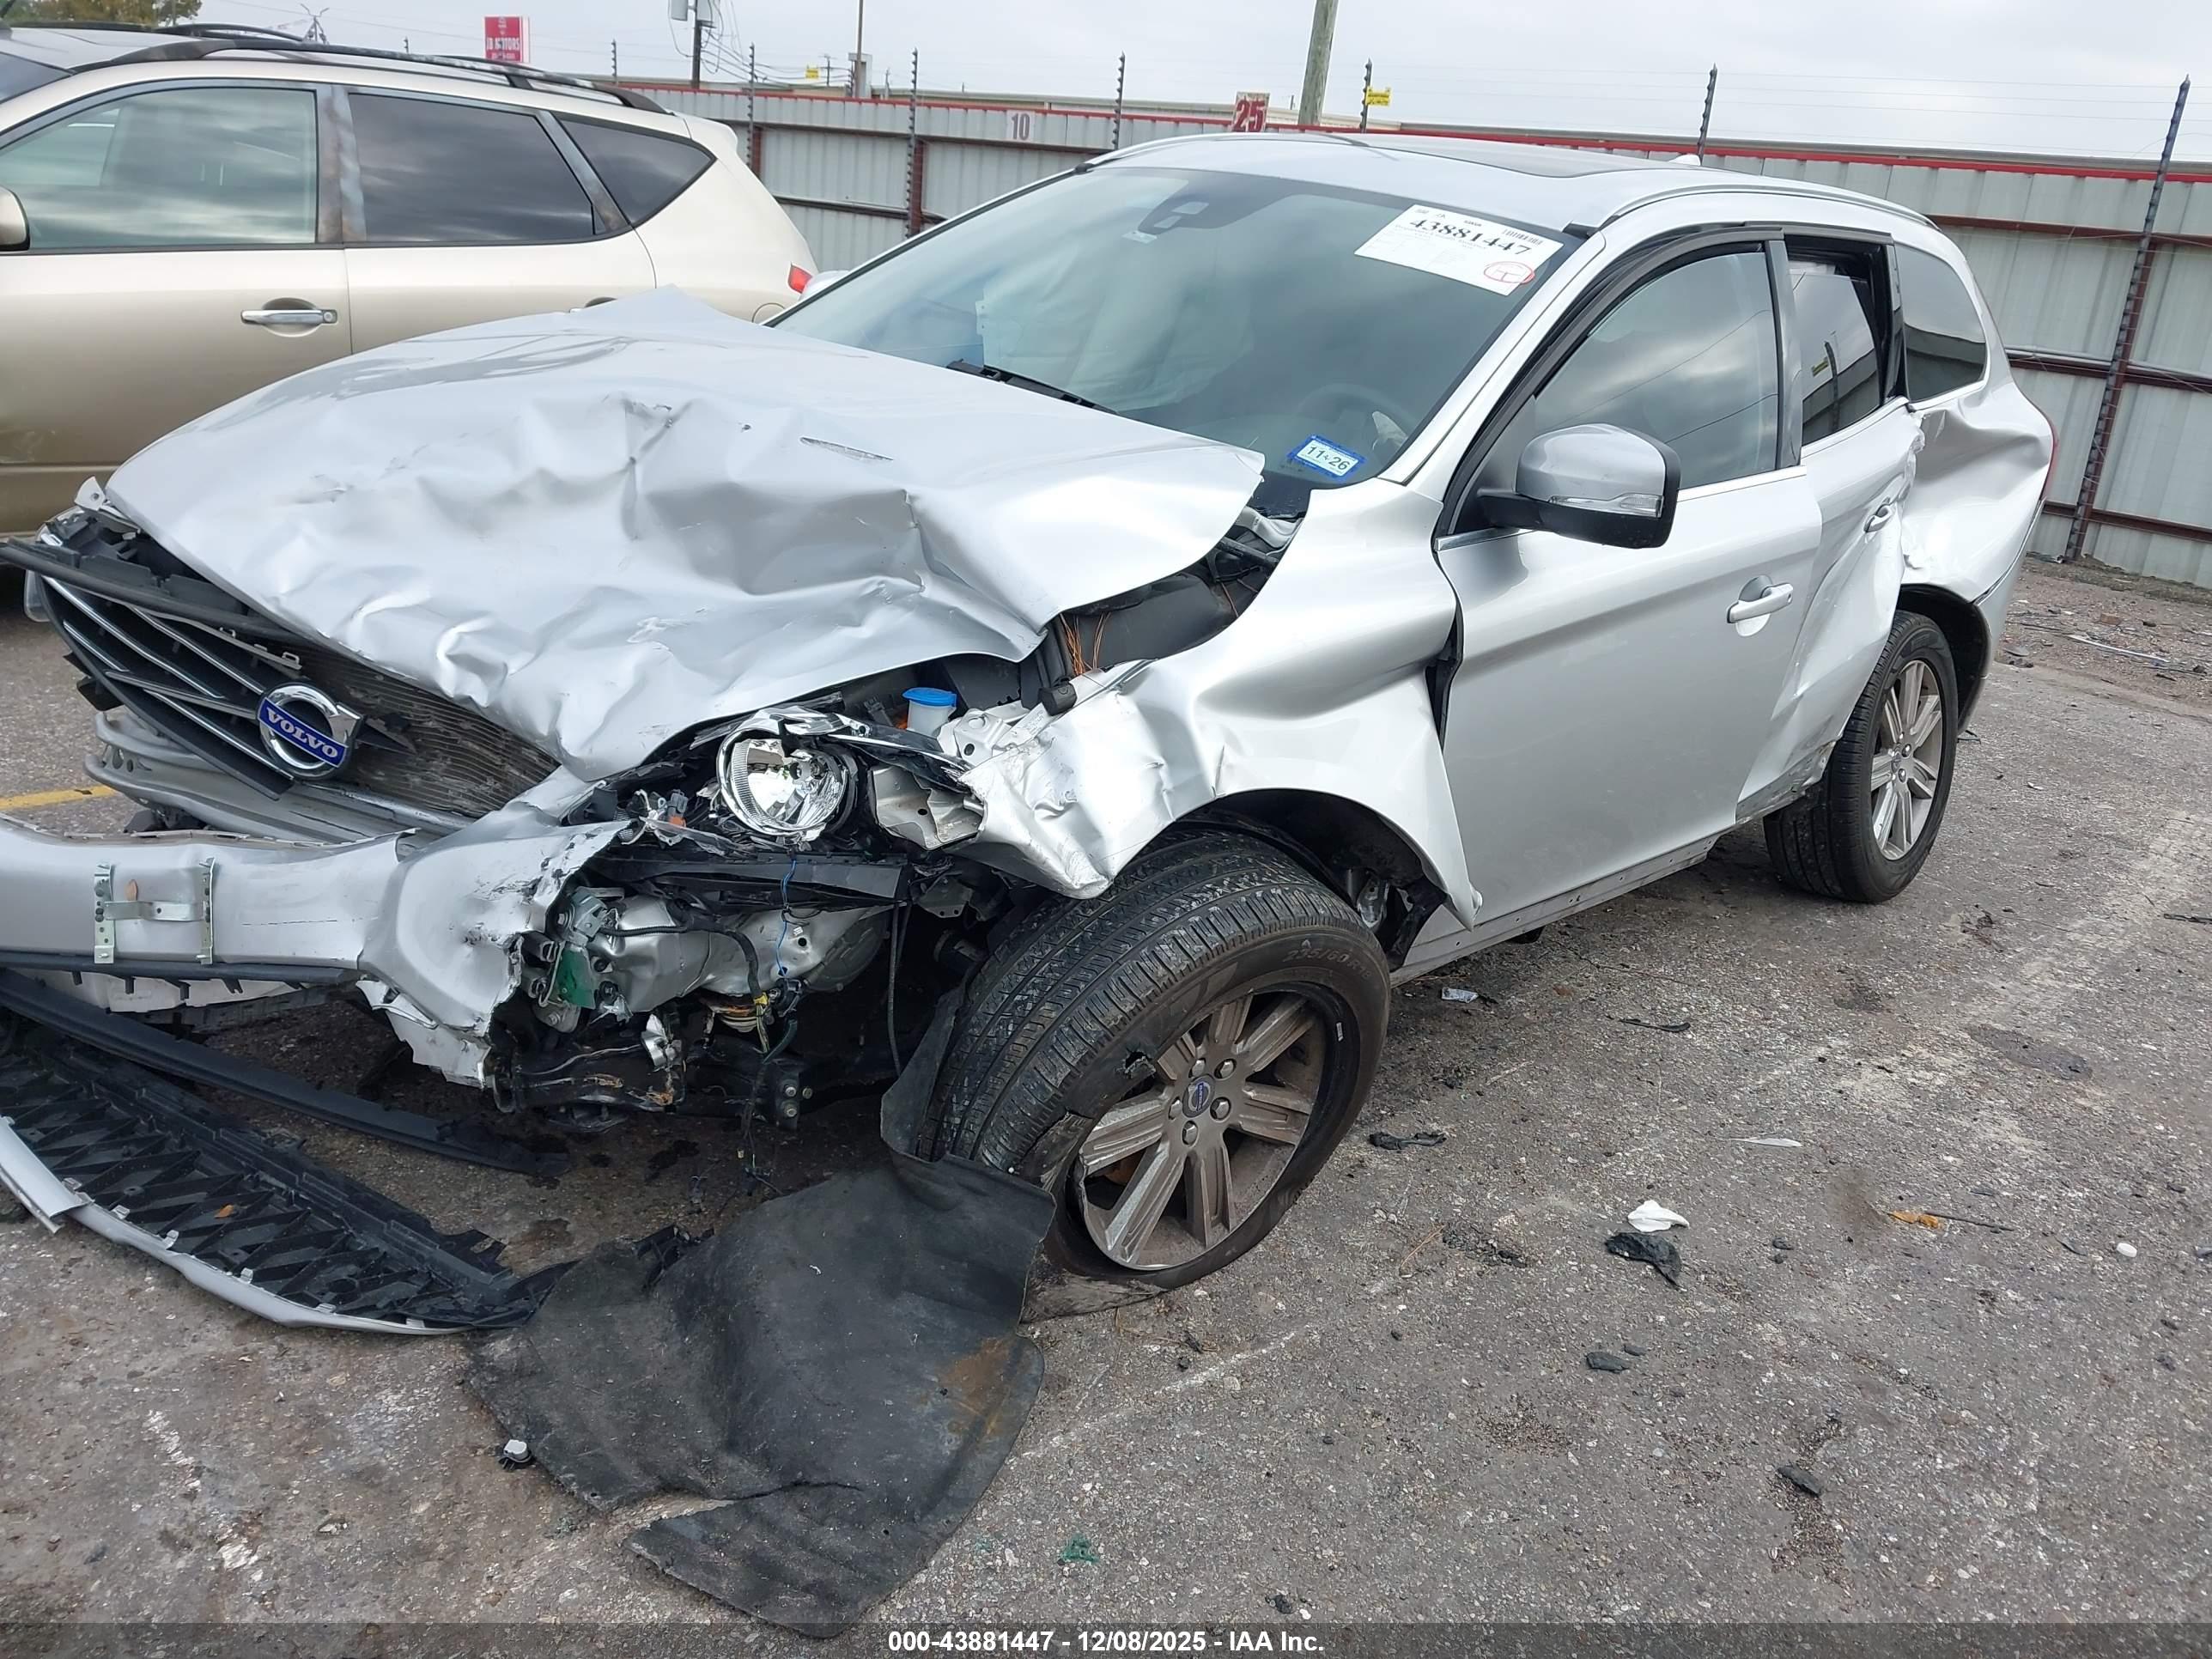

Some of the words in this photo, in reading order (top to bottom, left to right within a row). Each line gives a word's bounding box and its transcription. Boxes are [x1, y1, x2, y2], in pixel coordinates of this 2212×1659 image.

[1011, 112, 1030, 141] 10
[1231, 99, 1266, 132] 25
[1409, 218, 1532, 255] 43881447
[266, 707, 338, 758] VOLVO
